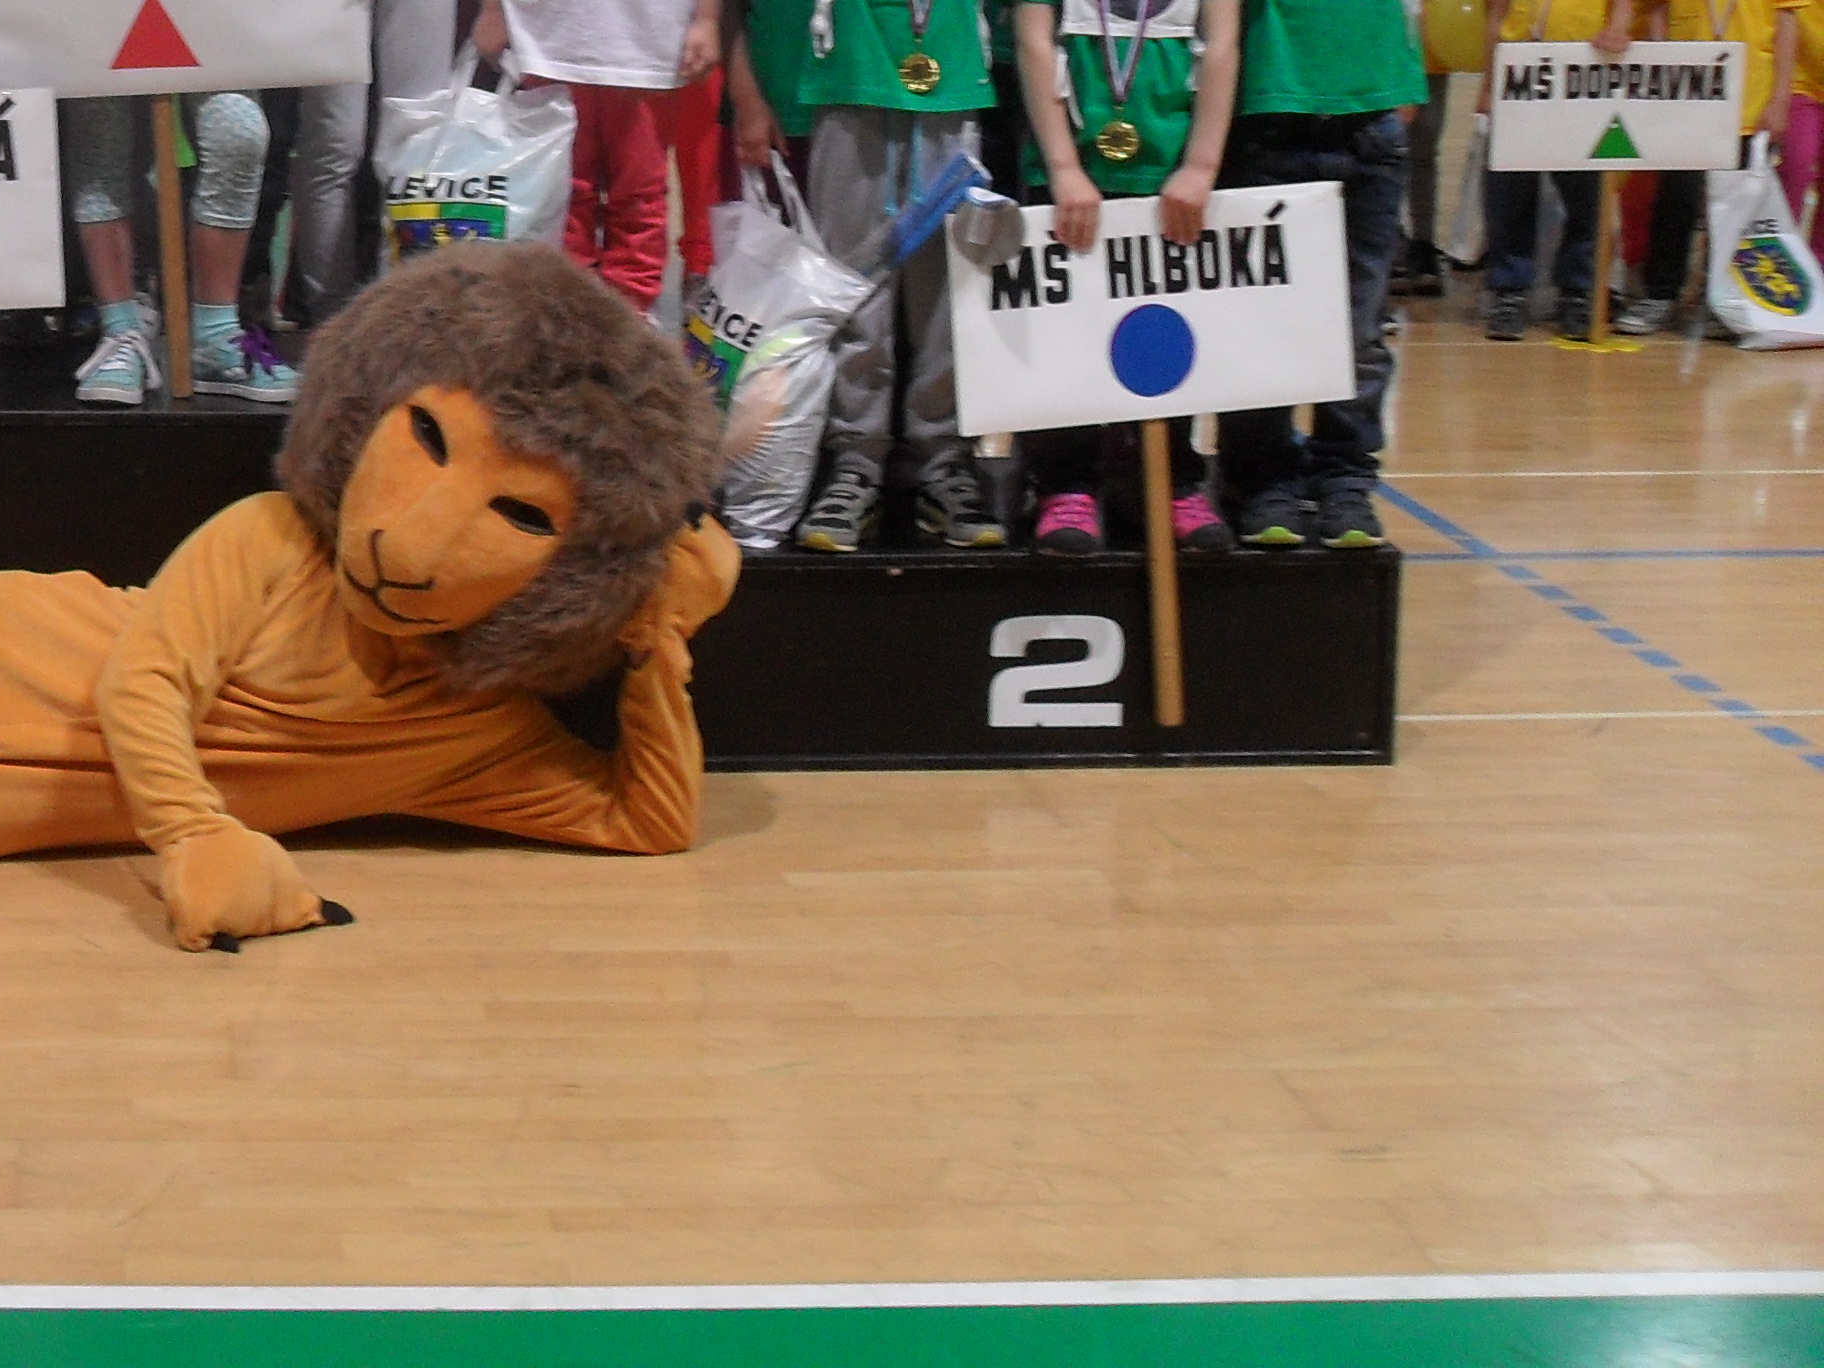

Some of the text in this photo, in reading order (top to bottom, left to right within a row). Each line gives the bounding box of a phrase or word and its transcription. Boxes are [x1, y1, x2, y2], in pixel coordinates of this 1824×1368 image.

[1502, 52, 1729, 100] MŠ DOPRAVNÁ
[386, 175, 509, 200] LEVICE
[1105, 200, 1290, 299] HLBOKÁ
[988, 615, 1125, 727] 2
